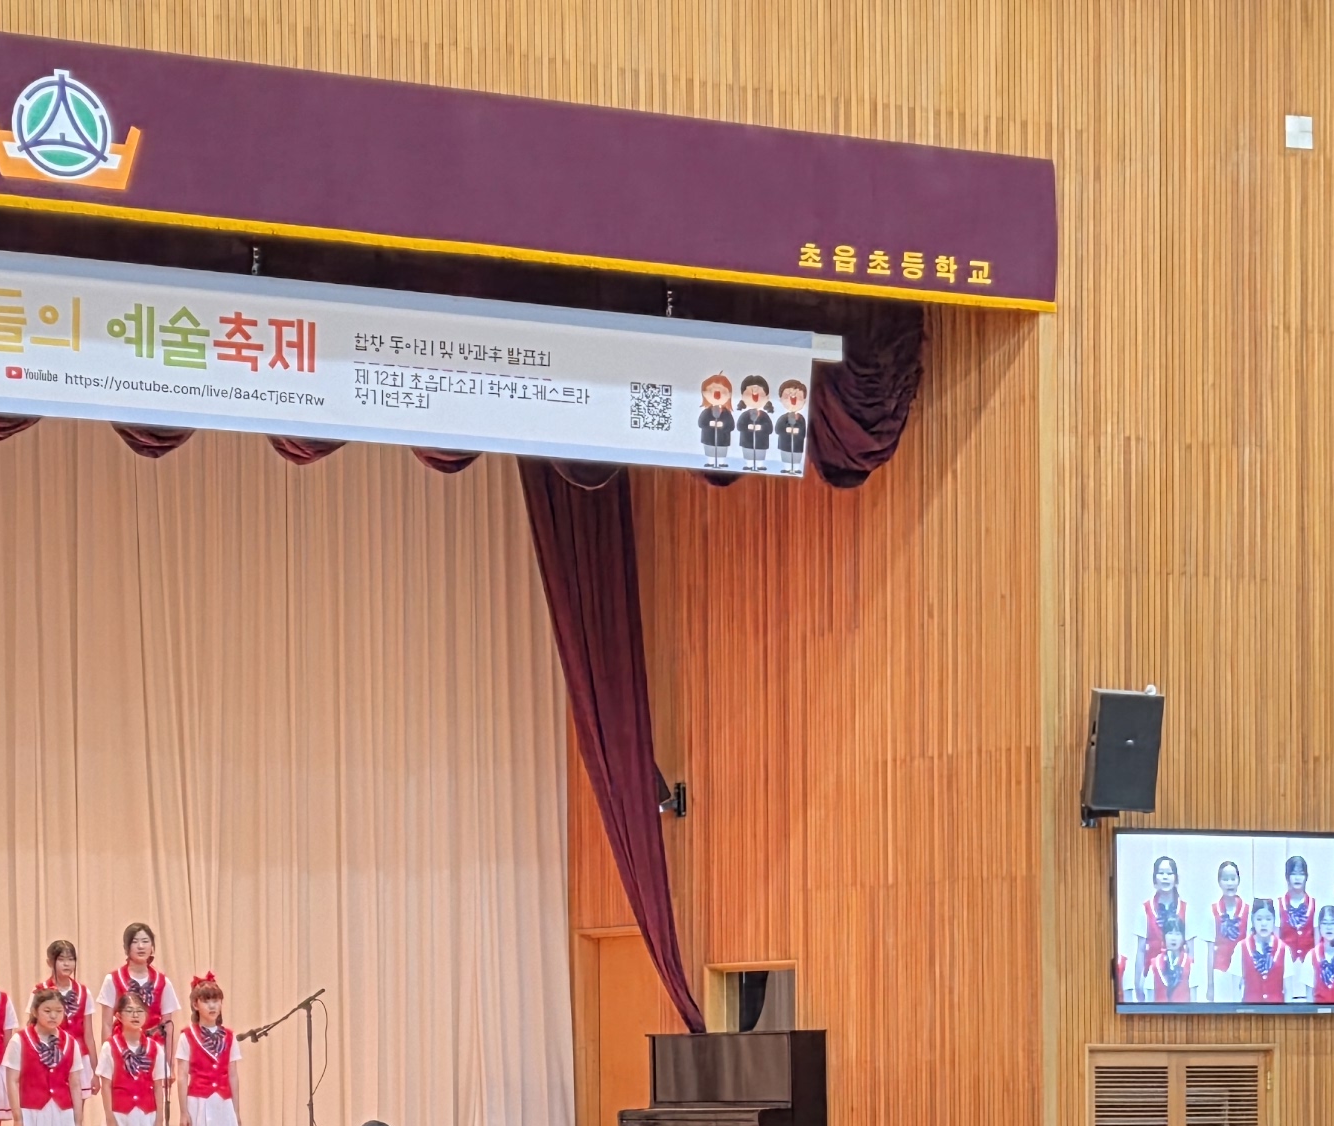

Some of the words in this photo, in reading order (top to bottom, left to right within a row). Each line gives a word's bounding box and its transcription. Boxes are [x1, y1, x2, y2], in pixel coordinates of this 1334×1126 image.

[798, 242, 992, 285] 초읍초등학교
[106, 303, 316, 373] 예술축제
[354, 332, 385, 353] 합창
[389, 336, 434, 356] 동아리
[439, 340, 454, 359] 및
[458, 342, 503, 363] 방과후
[507, 347, 551, 367] 발표회
[24, 367, 58, 383] YouTube
[354, 368, 370, 385] 제
[373, 370, 404, 388] 12회
[409, 374, 483, 396] 초읍다소리
[487, 380, 591, 405] 학생오케스트라
[354, 387, 430, 410] 정기연주회
